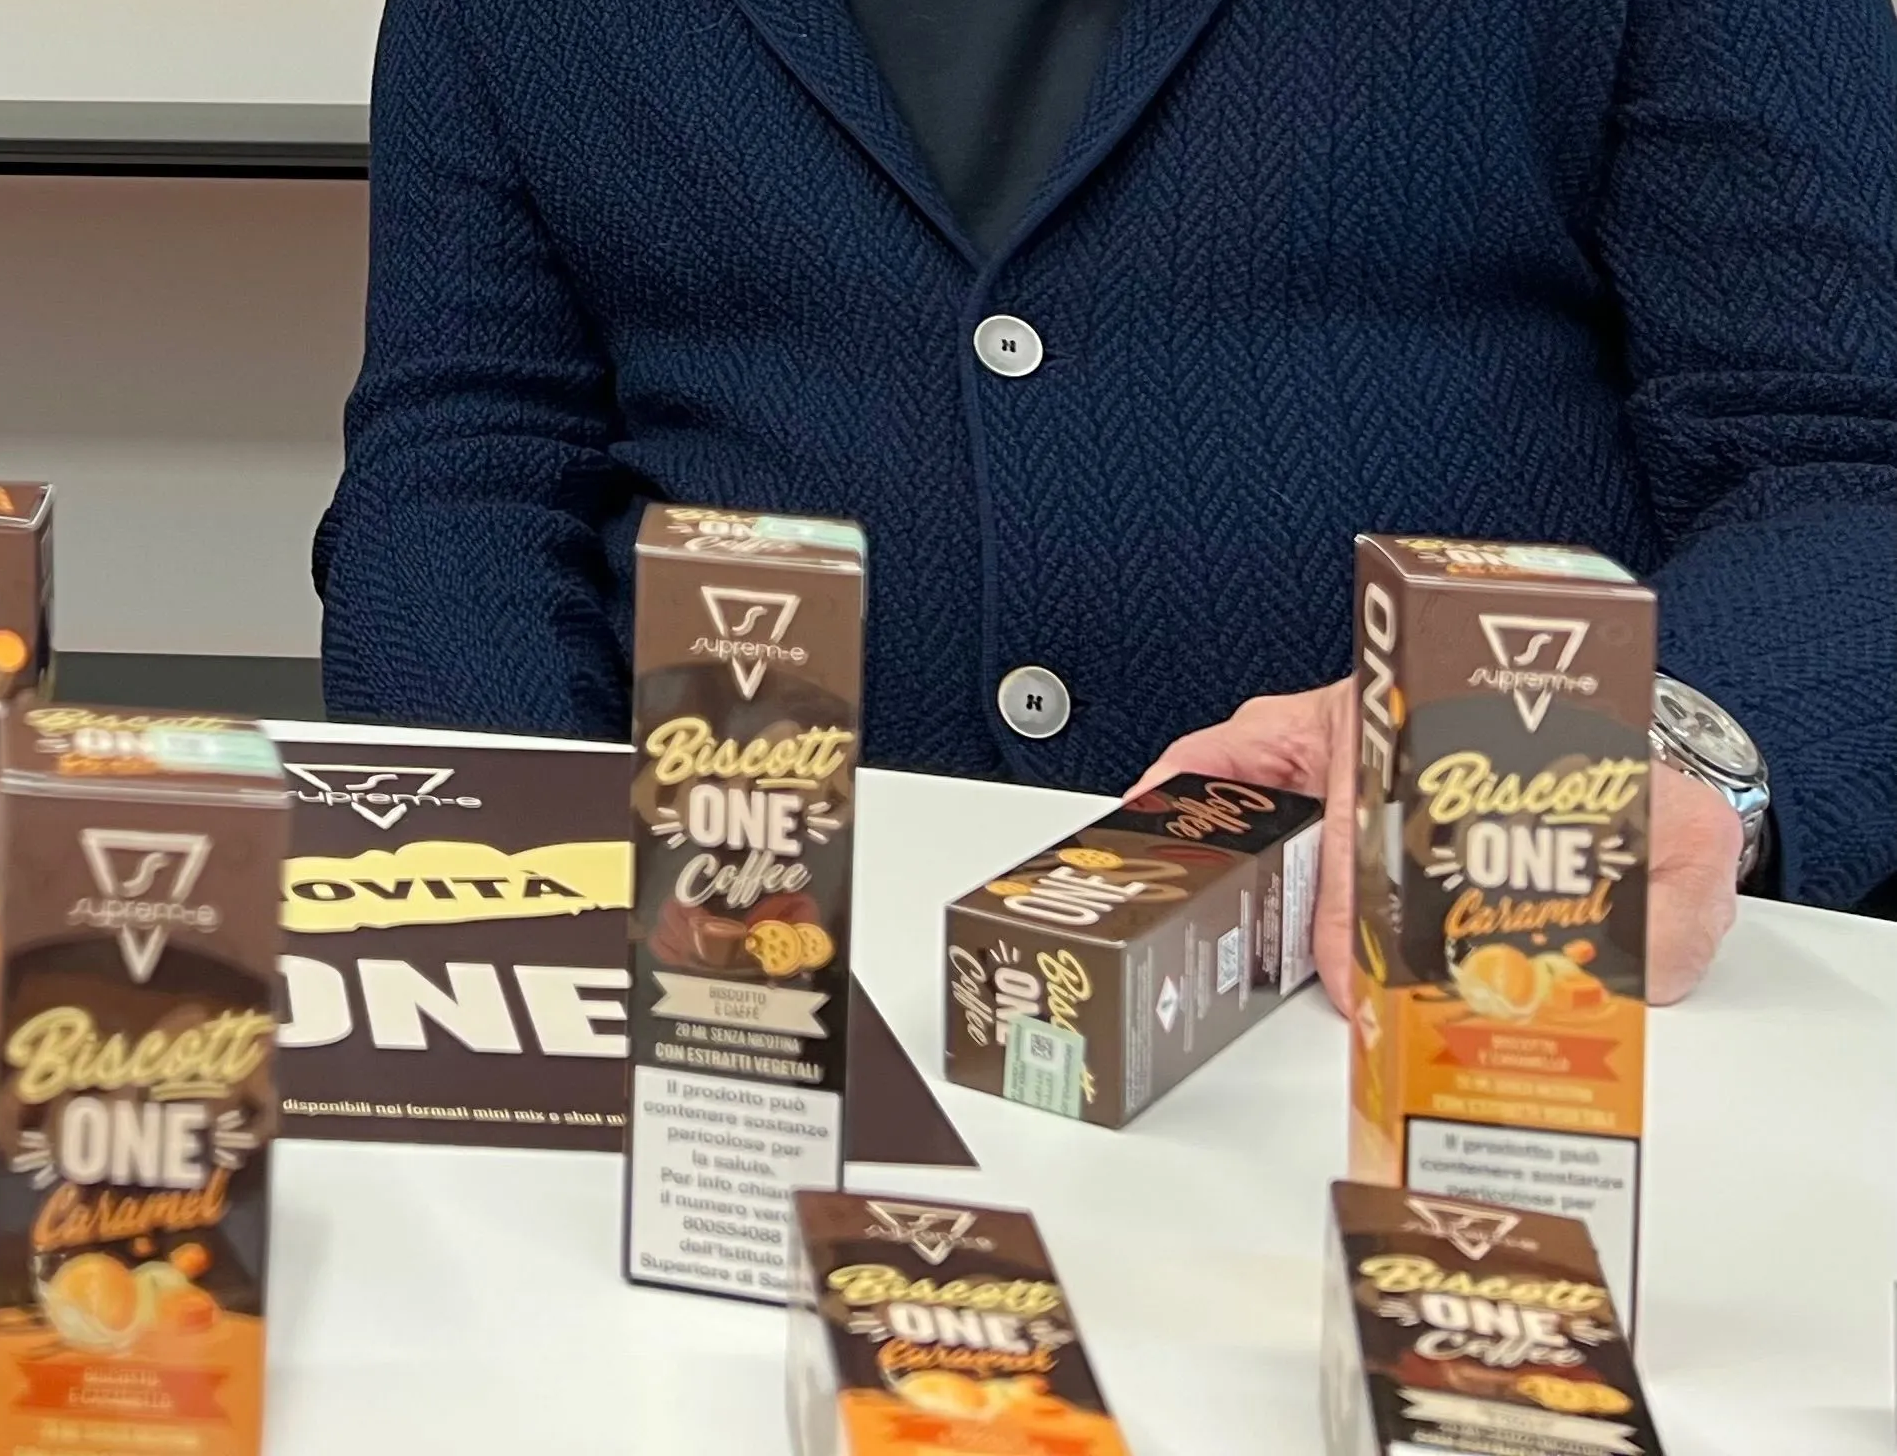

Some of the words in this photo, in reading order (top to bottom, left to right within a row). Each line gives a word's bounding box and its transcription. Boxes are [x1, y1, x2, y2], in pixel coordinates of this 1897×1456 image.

[690, 636, 809, 665] suprem-e
[1363, 582, 1396, 790] ONE
[1468, 665, 1600, 697] suprem-e
[646, 717, 855, 787] Biscott
[293, 786, 483, 808] uprem-e
[1165, 780, 1277, 841] Coffee
[1418, 750, 1650, 824] Biscott
[688, 785, 804, 857] ONE
[674, 851, 812, 910] Coffee
[1467, 822, 1594, 894] ONE
[281, 870, 587, 904] OVITÀ
[1003, 865, 1147, 927] ONE
[1444, 881, 1614, 938] Caramel
[709, 985, 767, 1006] BISCOTTO
[948, 944, 990, 1048] Coffee
[5, 1005, 276, 1104] Biscott
[654, 1042, 685, 1063] CON
[687, 1046, 752, 1072] ESTRATTI
[754, 1054, 821, 1082] VEGETALI
[710, 1027, 746, 1046] SENZA
[747, 1032, 801, 1054] NICOTINA
[282, 1098, 372, 1117] disponibili
[406, 1102, 468, 1119] formati
[472, 1107, 510, 1121] mini
[514, 1109, 544, 1121] mix
[563, 1110, 602, 1124] shot
[644, 1100, 737, 1126] contenere
[744, 1114, 828, 1139] sostanze
[683, 1082, 763, 1107] prodotto
[769, 1094, 806, 1114] può
[60, 1095, 207, 1189] ONE
[667, 1125, 765, 1153] pericolose
[771, 1142, 802, 1158] per
[661, 1166, 692, 1185] Per
[697, 1171, 732, 1192] info
[675, 1193, 748, 1216] numero
[32, 1166, 233, 1251] Caramel
[640, 1252, 730, 1282] Superiore
[827, 1264, 1061, 1316] Biscott
[1359, 1254, 1608, 1312] Biscott
[888, 1302, 1031, 1355] ONE
[1420, 1293, 1570, 1348] ONE
[1414, 1330, 1588, 1368] Coffee
